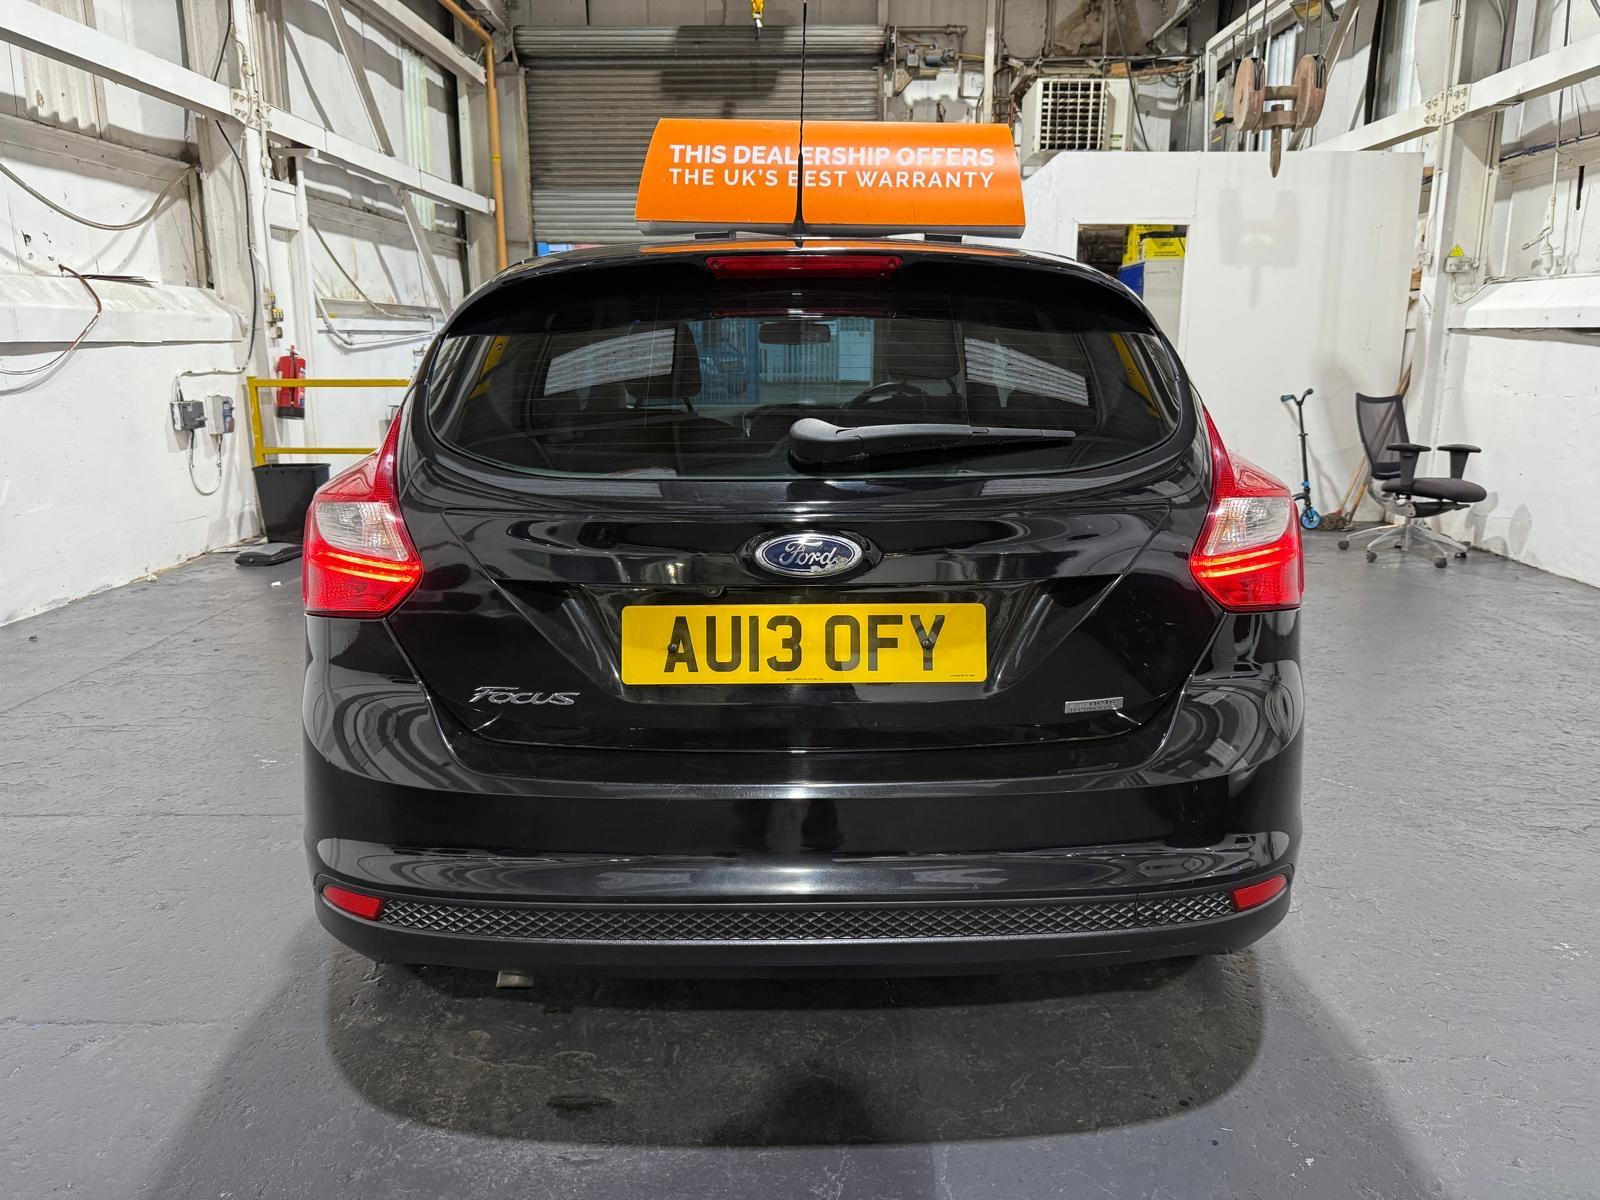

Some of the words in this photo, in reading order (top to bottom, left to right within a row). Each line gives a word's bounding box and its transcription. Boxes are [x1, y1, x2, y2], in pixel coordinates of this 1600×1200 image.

[669, 145, 727, 164] THIS
[733, 145, 891, 167] DEALERSHIP
[896, 147, 995, 167] OFFERS
[668, 168, 715, 186] THE
[724, 169, 779, 187] UK'S
[787, 170, 848, 188] BEST
[855, 171, 995, 189] WARRANTY
[779, 540, 838, 566] Ford
[663, 615, 803, 673] AU13
[824, 614, 946, 672] OFY
